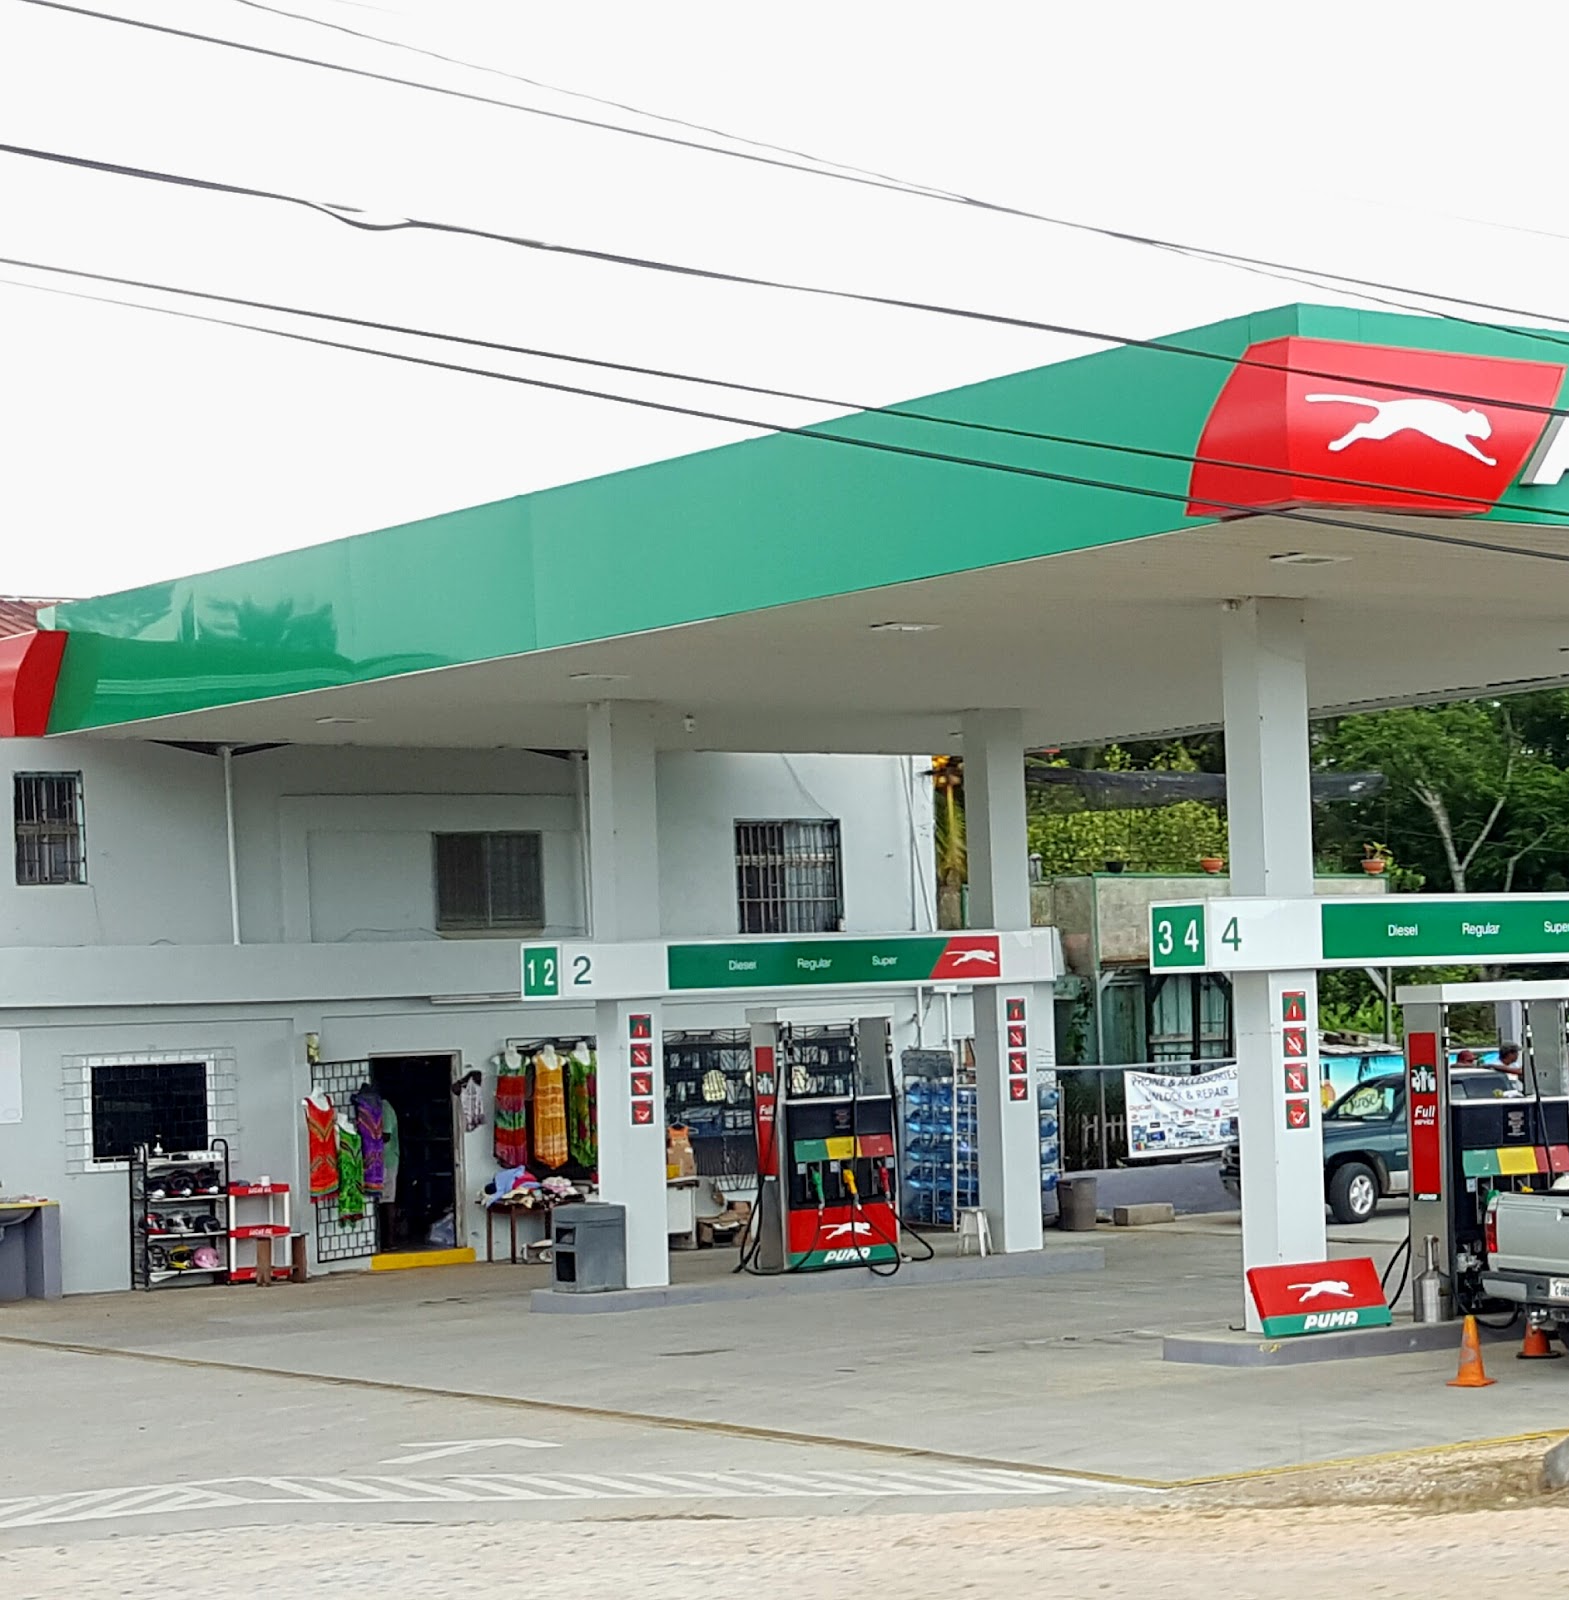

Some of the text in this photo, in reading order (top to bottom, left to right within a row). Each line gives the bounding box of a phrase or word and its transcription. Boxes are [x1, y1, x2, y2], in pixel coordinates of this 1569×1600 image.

[1221, 916, 1242, 952] 4
[1388, 924, 1418, 937] Diesel
[1462, 921, 1500, 937] Regular
[573, 955, 592, 985] 2
[728, 955, 898, 971] Diesel Regular Super
[1414, 1105, 1436, 1118] Full
[823, 1247, 871, 1263] PUMA
[1303, 1311, 1359, 1330] PUMA
